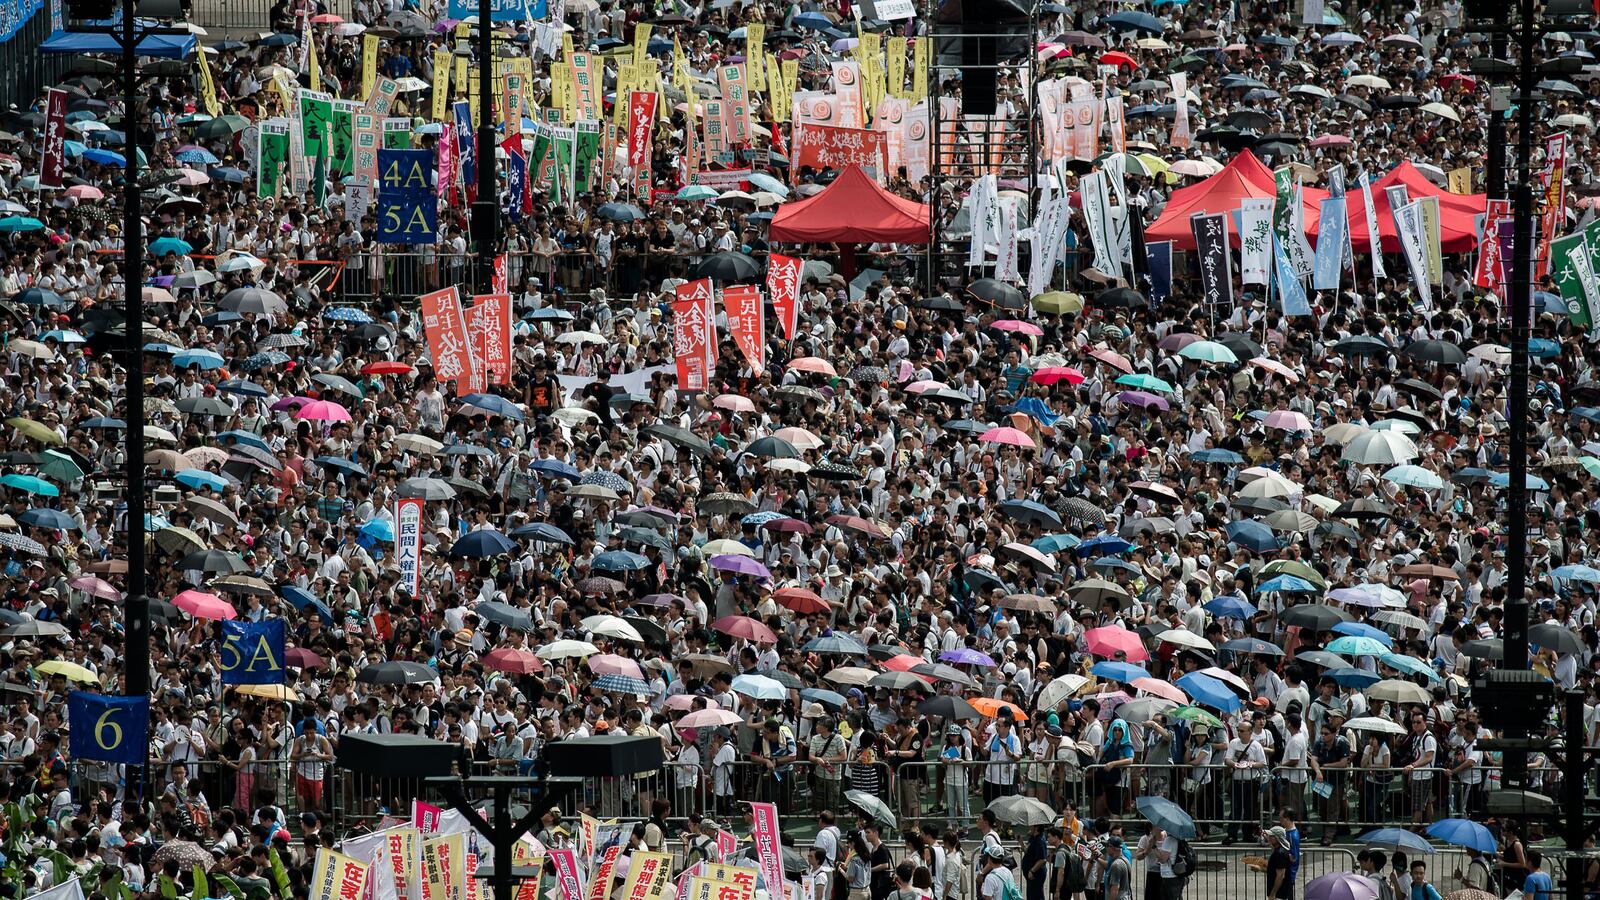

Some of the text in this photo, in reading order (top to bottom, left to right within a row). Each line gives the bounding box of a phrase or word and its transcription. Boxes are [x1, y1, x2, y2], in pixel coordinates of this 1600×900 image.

[383, 160, 427, 188] 4A
[384, 205, 432, 234] 5A
[437, 294, 464, 378] 民主必勝
[221, 634, 283, 672] 5A
[95, 708, 123, 750] 6
[590, 847, 620, 900] 我要活
[631, 858, 658, 900] 特別傷
